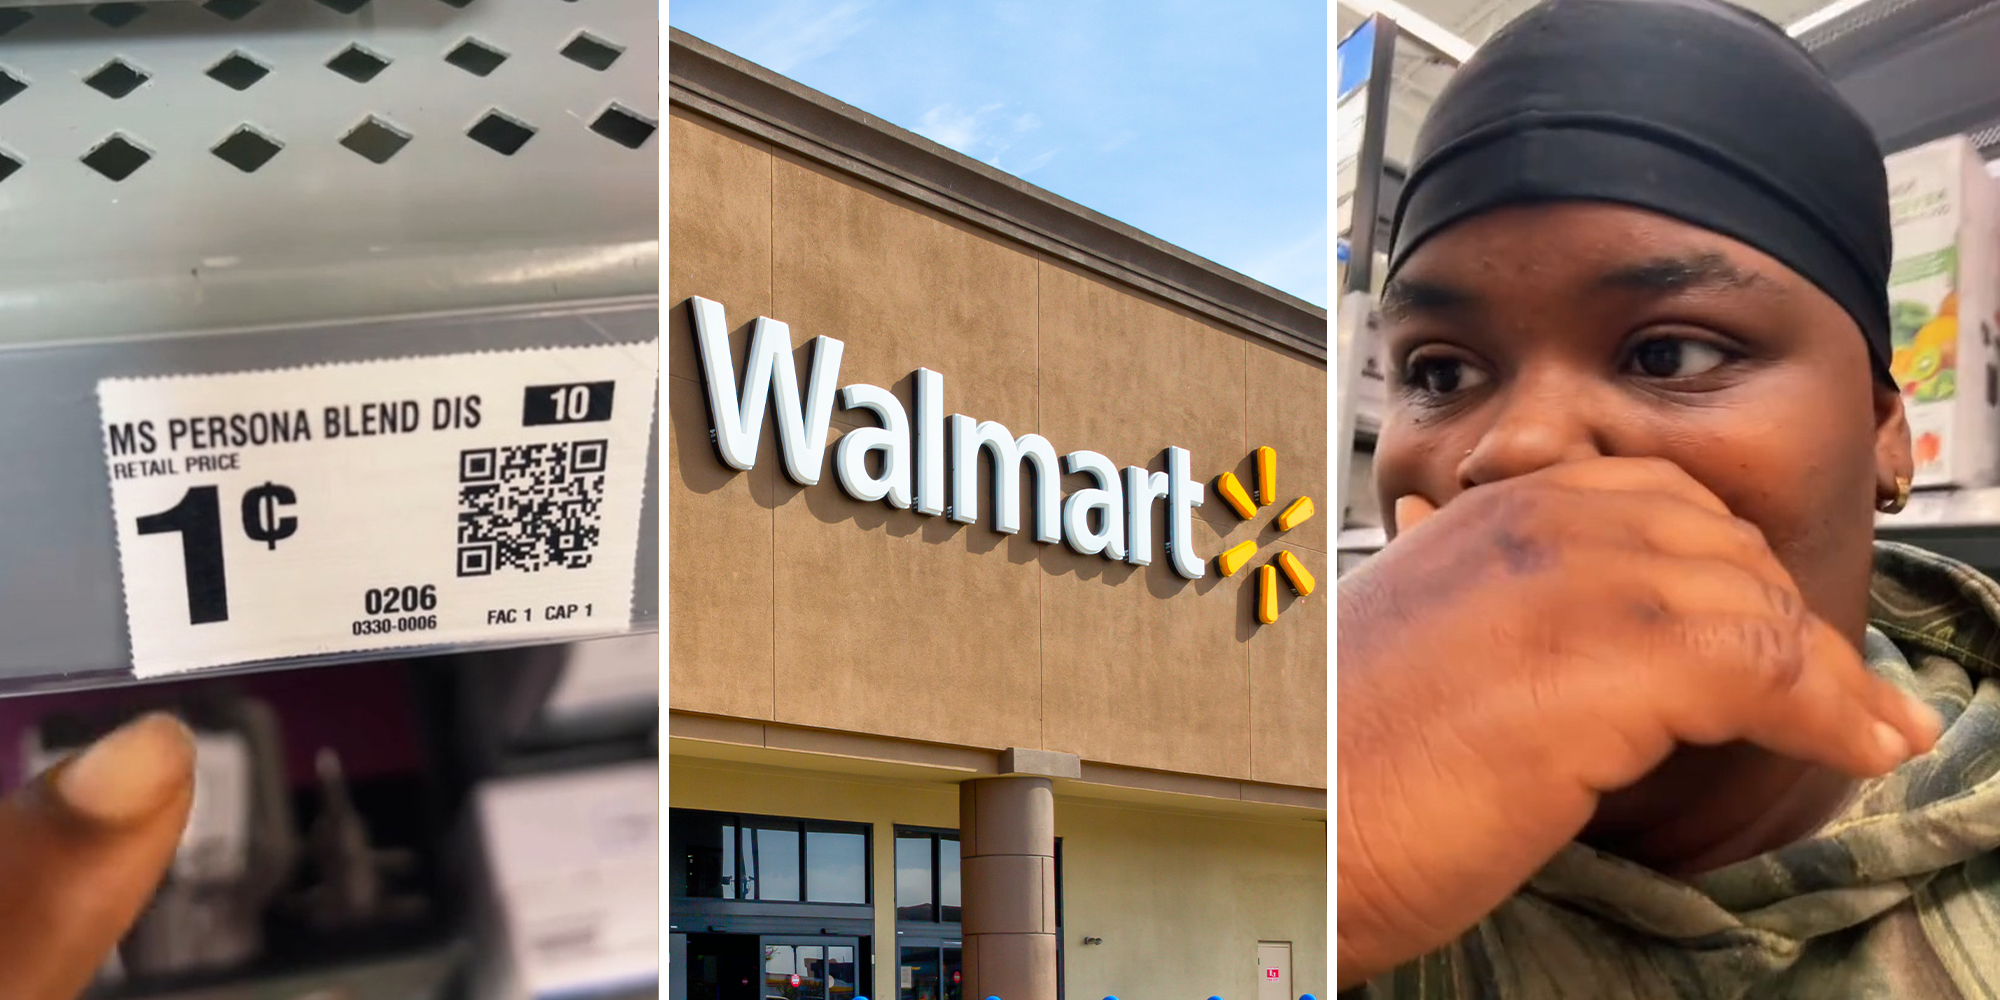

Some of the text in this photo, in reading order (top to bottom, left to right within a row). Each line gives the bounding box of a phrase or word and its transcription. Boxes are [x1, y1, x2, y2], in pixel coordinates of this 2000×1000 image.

[551, 386, 591, 421] 10
[108, 394, 482, 456] MS PERSONA BLEND DIS
[689, 294, 1207, 581] Walmart
[113, 452, 241, 480] RETAIL PRICE
[135, 481, 299, 627] 1¢
[364, 583, 438, 617] 0206
[486, 602, 594, 626] FAC 1 CAP 1
[351, 613, 438, 637] 0330-0006
